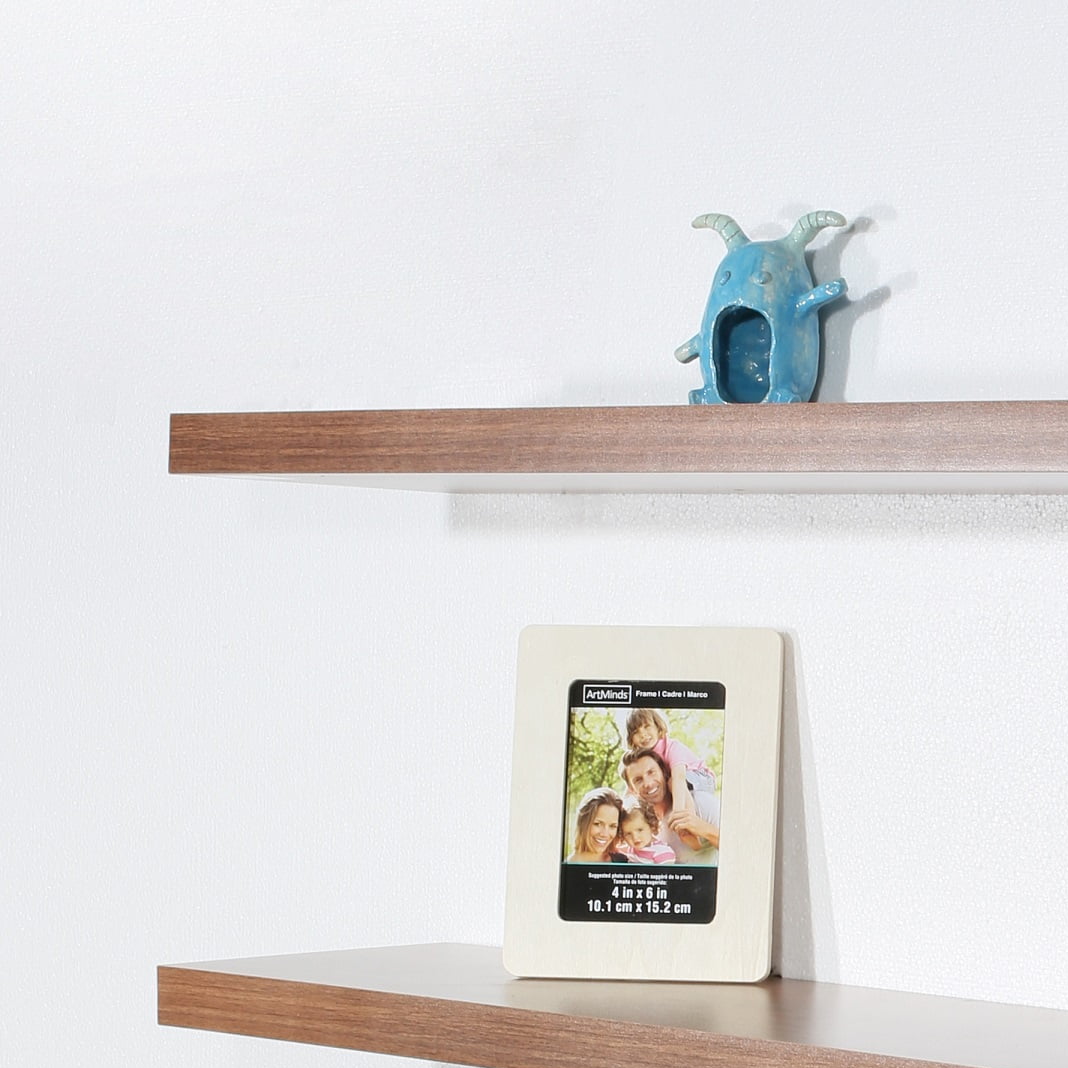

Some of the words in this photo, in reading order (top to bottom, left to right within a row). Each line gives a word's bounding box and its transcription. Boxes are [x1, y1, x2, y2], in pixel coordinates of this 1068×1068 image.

[586, 689, 628, 700] ArtMinds
[635, 690, 657, 698] Frame
[662, 690, 682, 698] Cadre
[687, 691, 709, 699] Marco
[612, 886, 619, 898] 4
[622, 886, 633, 899] in
[636, 889, 643, 899] x
[646, 886, 653, 899] 6
[656, 887, 668, 900] in
[587, 899, 612, 912] 10.1
[615, 903, 633, 912] cm
[636, 903, 642, 912] x
[645, 901, 671, 914] 15.2
[674, 903, 691, 914] cm
